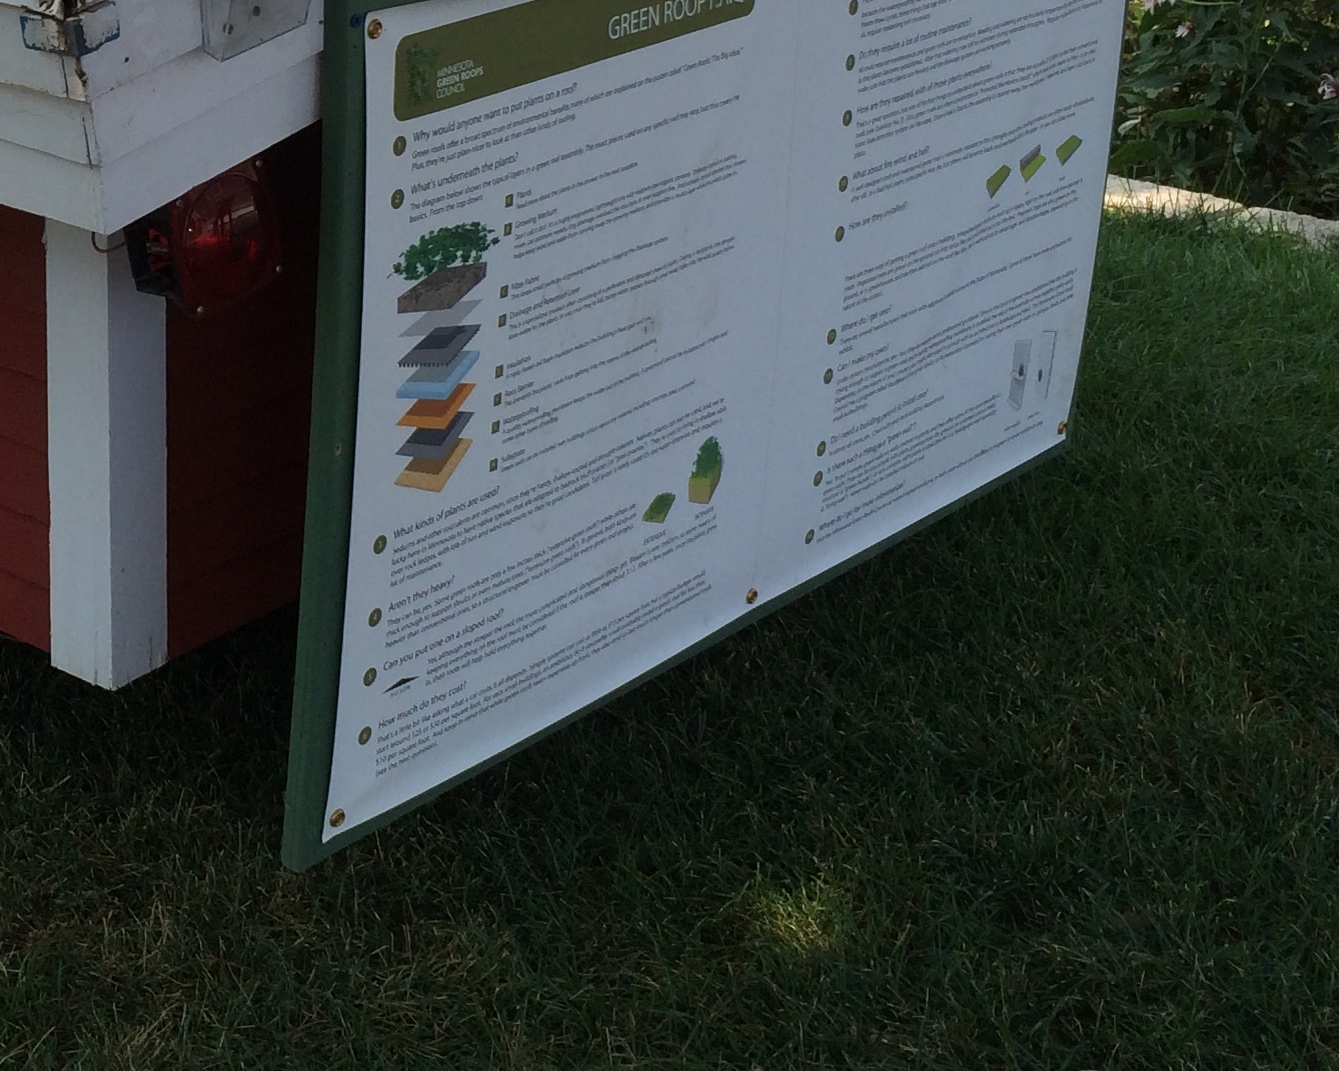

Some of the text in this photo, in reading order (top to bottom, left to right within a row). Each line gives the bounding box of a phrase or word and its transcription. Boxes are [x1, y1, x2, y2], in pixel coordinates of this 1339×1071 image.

[608, 4, 660, 40] GREEN
[435, 83, 465, 99] COUNCIL
[436, 74, 459, 88] GREEN
[412, 130, 430, 143] Why
[432, 121, 455, 137] would
[456, 114, 482, 129] anyone
[483, 106, 500, 121] want
[501, 105, 509, 115] to
[510, 99, 522, 115] put
[523, 94, 543, 111] plants
[545, 92, 554, 101] on
[561, 82, 577, 96] roof?
[410, 152, 518, 195] What's underneath the plants?
[393, 485, 499, 541] What kinds of plants are used?
[388, 574, 454, 613] Aren't they heavy?
[383, 659, 398, 672] Can
[399, 652, 413, 667] you
[414, 643, 427, 660] put
[428, 638, 443, 650] one
[444, 632, 454, 643] on
[461, 616, 485, 635] sloped
[378, 679, 467, 730] How much do they cost?
